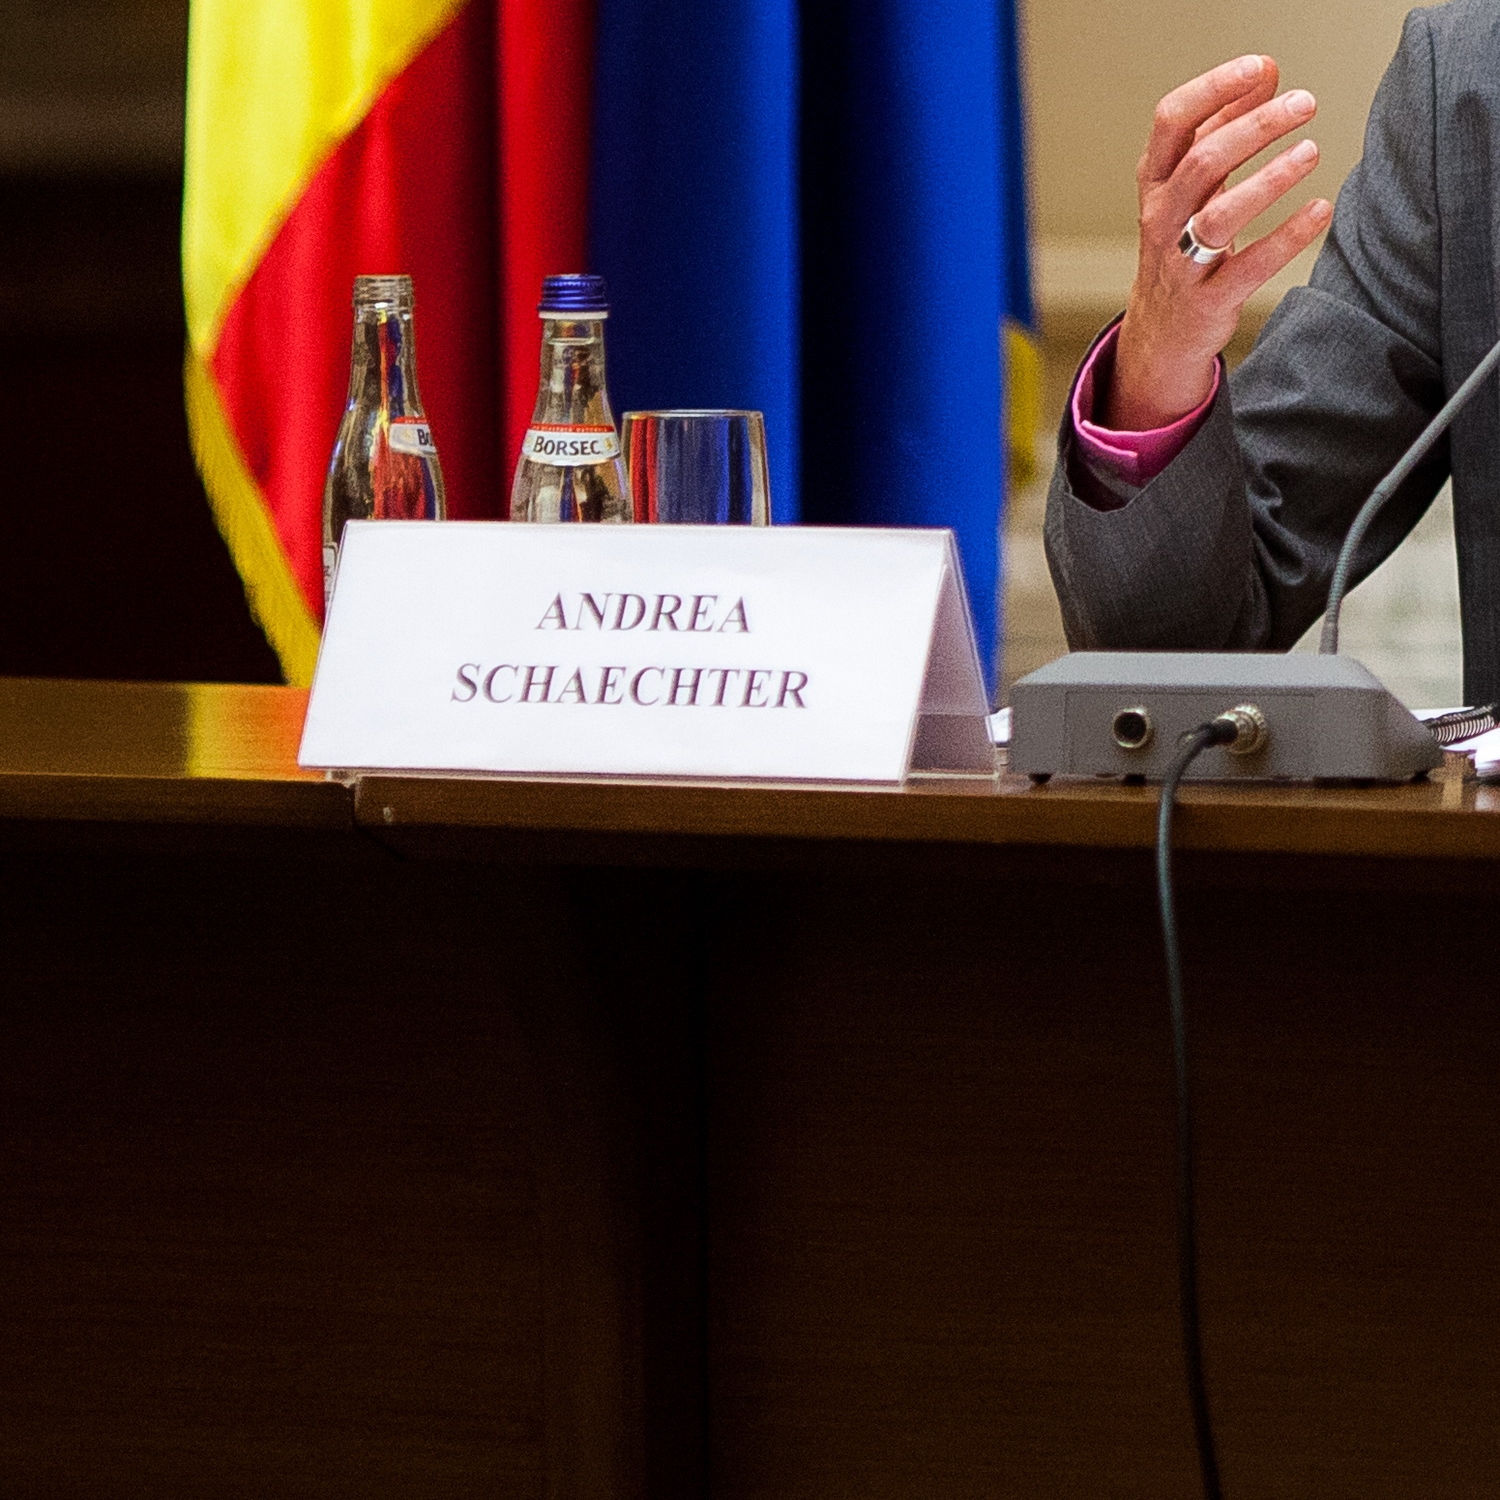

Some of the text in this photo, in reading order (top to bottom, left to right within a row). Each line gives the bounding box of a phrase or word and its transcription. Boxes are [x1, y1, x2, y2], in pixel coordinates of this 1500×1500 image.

[533, 435, 602, 456] BORSEC
[534, 591, 751, 633] ANDREA
[450, 662, 809, 709] SCHAECHTER
